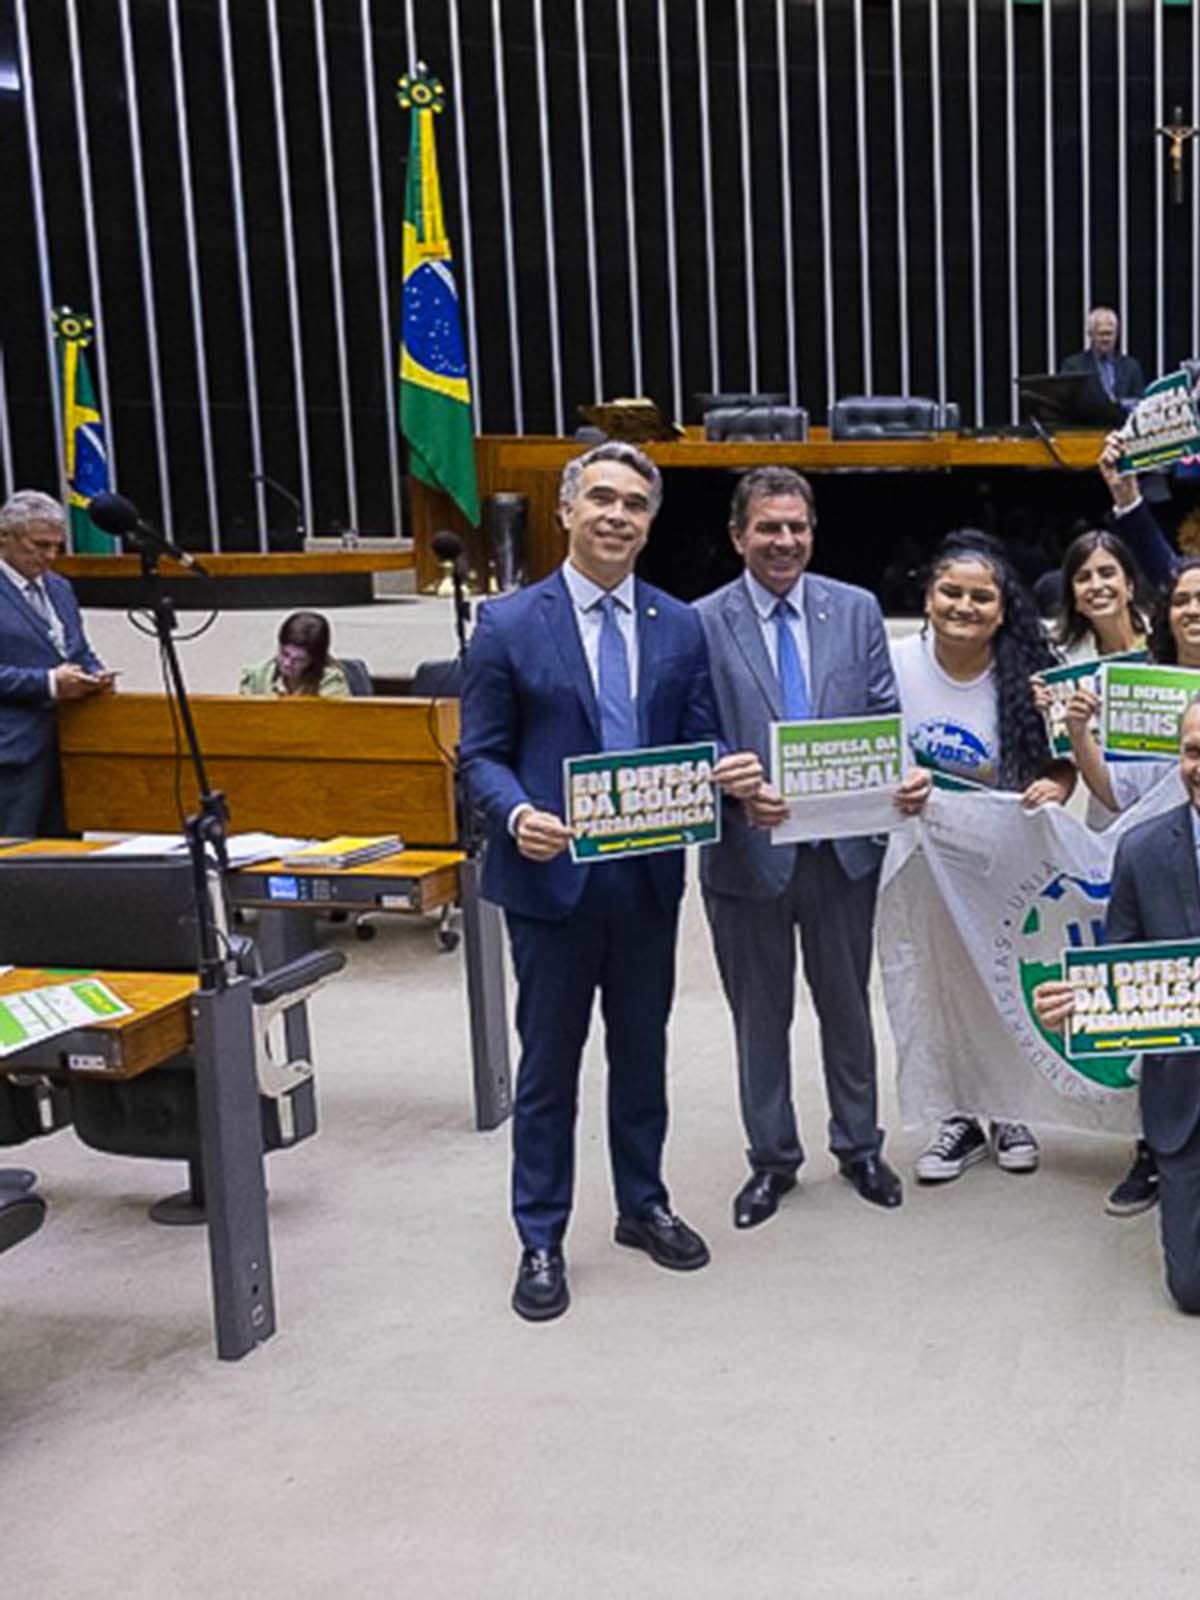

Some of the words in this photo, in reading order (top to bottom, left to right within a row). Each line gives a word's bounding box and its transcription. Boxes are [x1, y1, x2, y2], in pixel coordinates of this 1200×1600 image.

[1109, 710, 1179, 735] MENS
[783, 744, 807, 758] EM
[811, 738, 870, 756] DEFESA
[573, 770, 612, 796] EM
[616, 760, 713, 793] DEFESA
[783, 761, 898, 795] MENSAL
[573, 793, 616, 821] DA
[621, 782, 714, 818] BOLSA
[1069, 964, 1109, 989] EM
[1073, 988, 1112, 1012] DA
